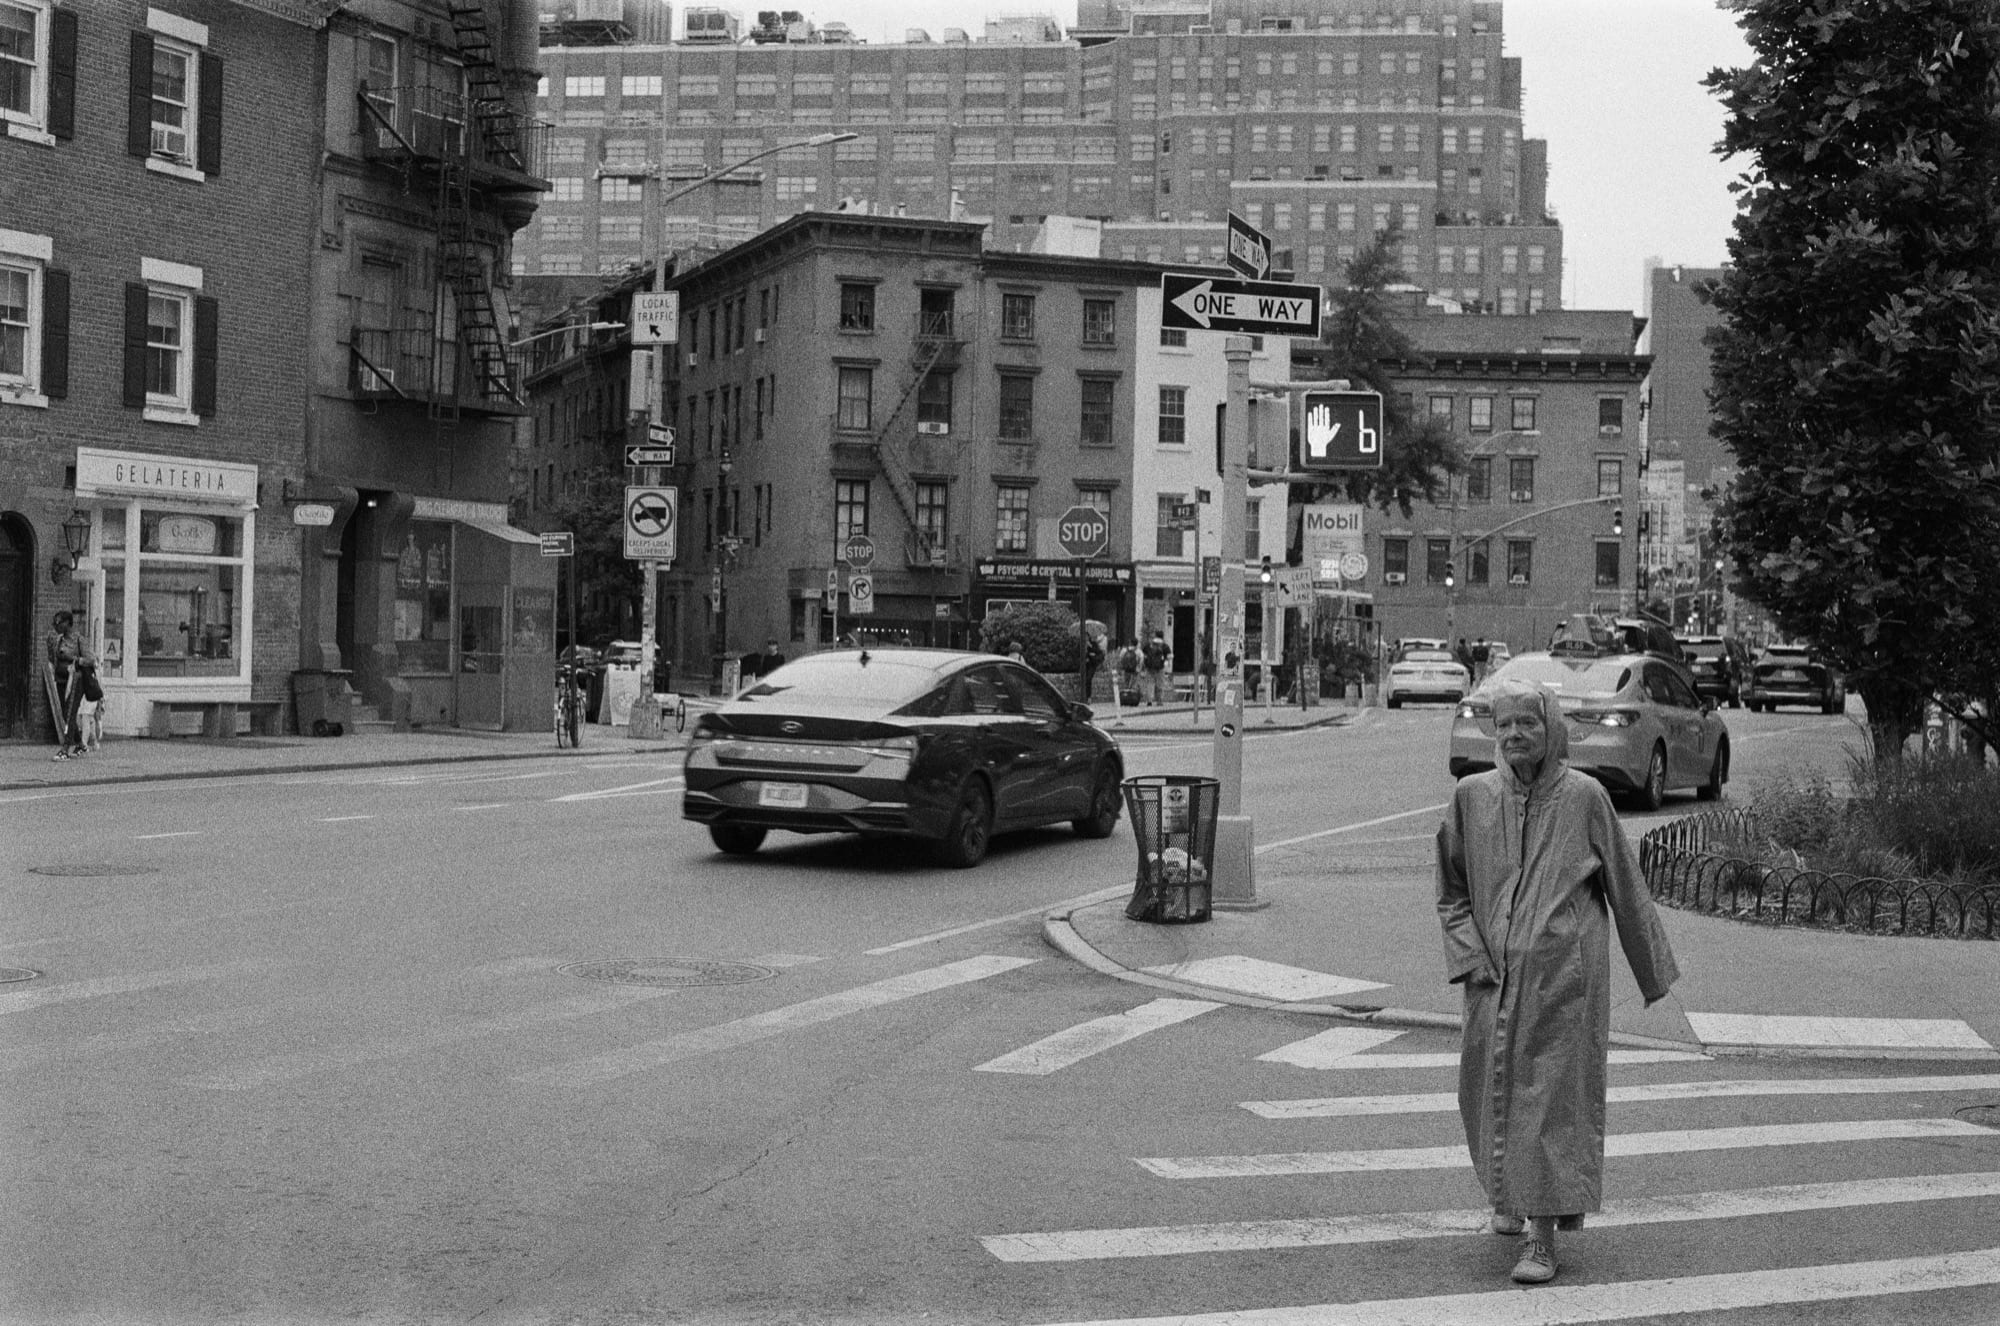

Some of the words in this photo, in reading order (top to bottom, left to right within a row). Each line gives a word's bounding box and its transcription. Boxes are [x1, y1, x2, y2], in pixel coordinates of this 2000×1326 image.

[1233, 232, 1247, 258] ONE
[1251, 246, 1266, 267] WAY
[642, 299, 670, 309] LOCAL
[1194, 294, 1236, 316] ONE
[1258, 298, 1303, 321] WAY
[638, 311, 673, 322] TRAFFIC
[653, 452, 667, 461] WAY
[116, 463, 225, 490] GELATERIA
[1307, 513, 1358, 530] Mobil
[1062, 523, 1104, 542] STOP
[652, 540, 671, 548] LOCAL
[846, 545, 873, 559] STOP
[997, 564, 1030, 576] PSYCHIC
[1075, 567, 1114, 578] RADINGS
[1291, 572, 1309, 581] LEFT
[1292, 583, 1311, 592] TURN
[1293, 593, 1310, 602] LANE
[106, 641, 117, 655] A
